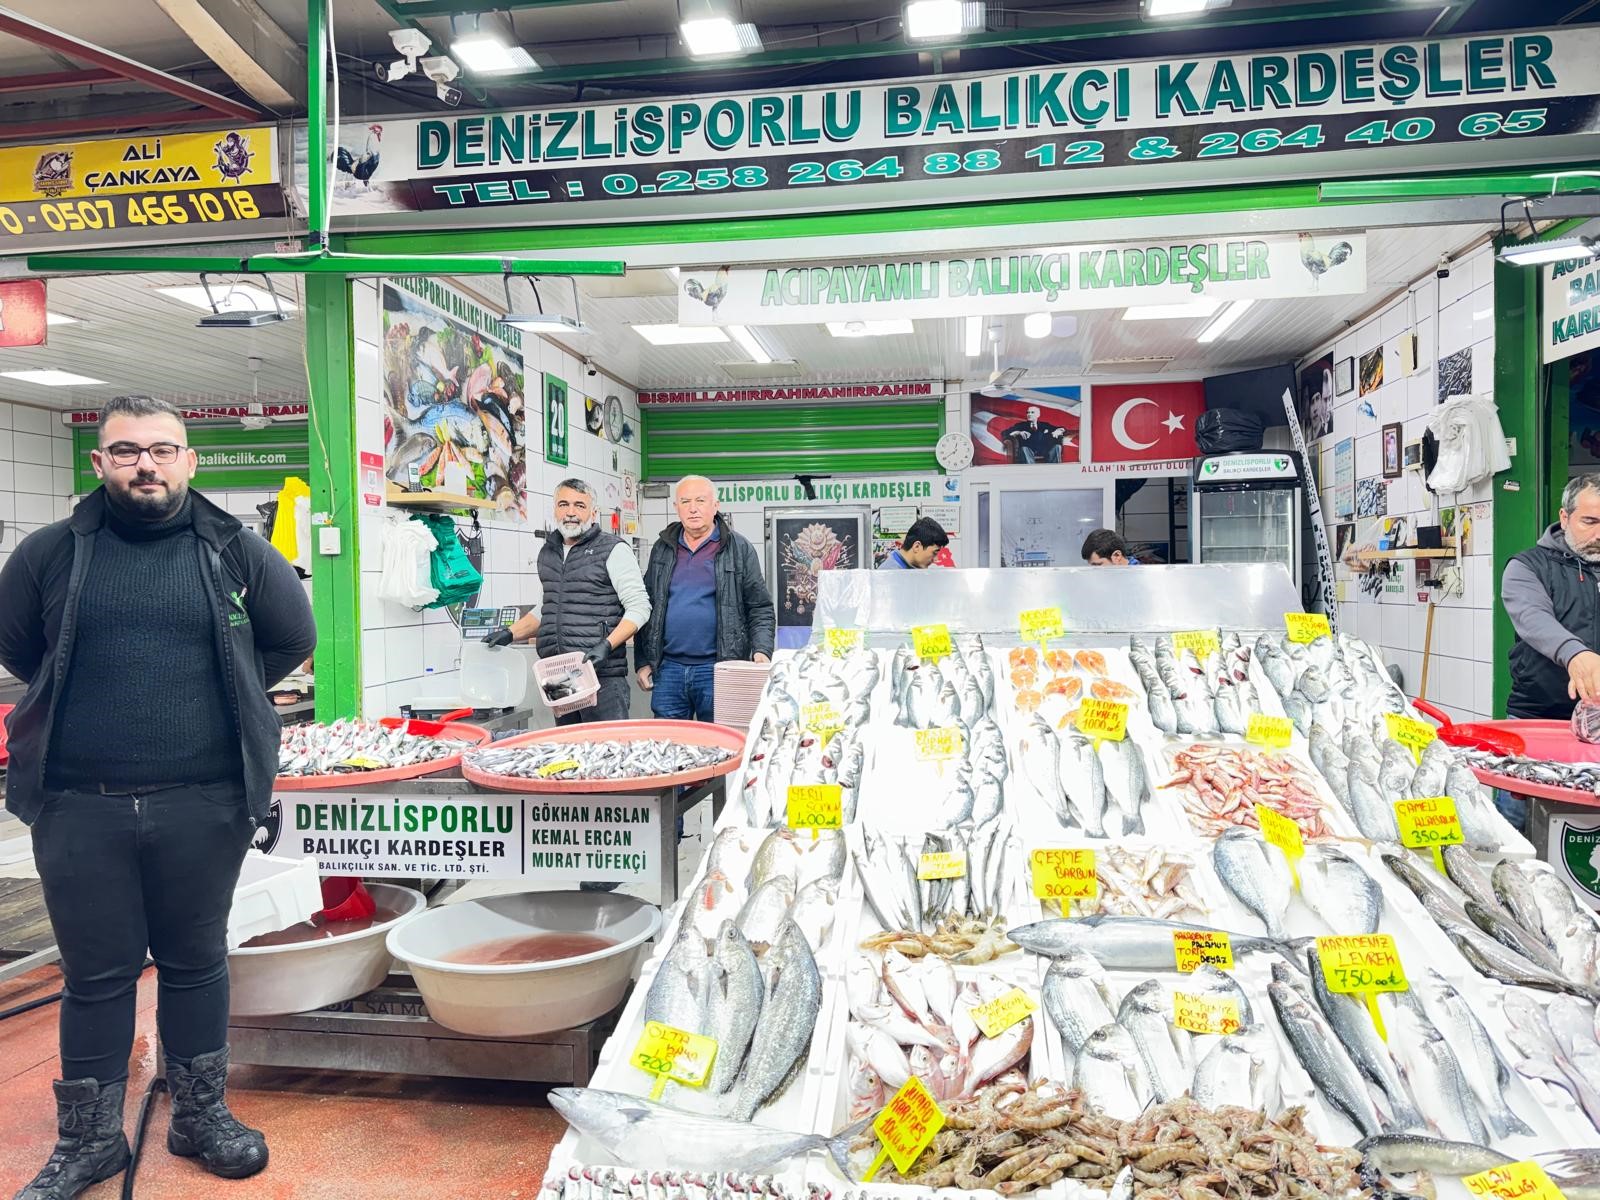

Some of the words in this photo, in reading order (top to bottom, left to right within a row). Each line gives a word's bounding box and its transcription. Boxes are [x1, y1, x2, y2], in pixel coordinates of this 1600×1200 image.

[884, 67, 1131, 138] BALIKÇI
[1155, 34, 1558, 118] KARDEŞLER
[122, 139, 162, 162] ALİ
[433, 178, 550, 204] TEL
[602, 164, 768, 196] 0.258
[788, 156, 903, 185] 264
[923, 149, 1001, 175] 88
[1025, 140, 1105, 167] 12
[1128, 136, 1182, 160] &
[1197, 124, 1326, 158] 264
[1345, 116, 1436, 145] 40
[1458, 108, 1548, 138] 65
[85, 166, 200, 192] ÇANKAYA
[40, 200, 115, 232] 0507
[128, 195, 189, 226] 466
[189, 192, 224, 222] 10
[223, 190, 261, 220] 18
[761, 260, 939, 306] ACIPAYAMLI
[948, 253, 1071, 302] BALIKÇI
[1079, 240, 1272, 293] KARDEŞLER
[453, 294, 482, 332] BALIKÇI
[197, 452, 287, 465] balikcilik.com
[852, 481, 931, 499] KARDEŞLER
[295, 797, 514, 834] DENİZLİSPORLU
[531, 803, 590, 823] GÖKHAN
[594, 805, 650, 824] ARSLAN
[303, 837, 381, 859] BALIKÇI
[387, 839, 506, 861] KARDEŞLER
[531, 829, 580, 846] KEMAL
[584, 830, 632, 846] ERCAN
[318, 861, 375, 873] BALIKÇILIK
[378, 862, 402, 873] SAN.
[404, 862, 417, 872] VE
[420, 861, 442, 873] TİC.
[444, 863, 466, 874] LTD.
[469, 862, 490, 875] ŞTİ.
[531, 851, 583, 869] MURAT
[585, 849, 647, 874] TÜFEKÇİ
[1339, 951, 1396, 968] LEVREK
